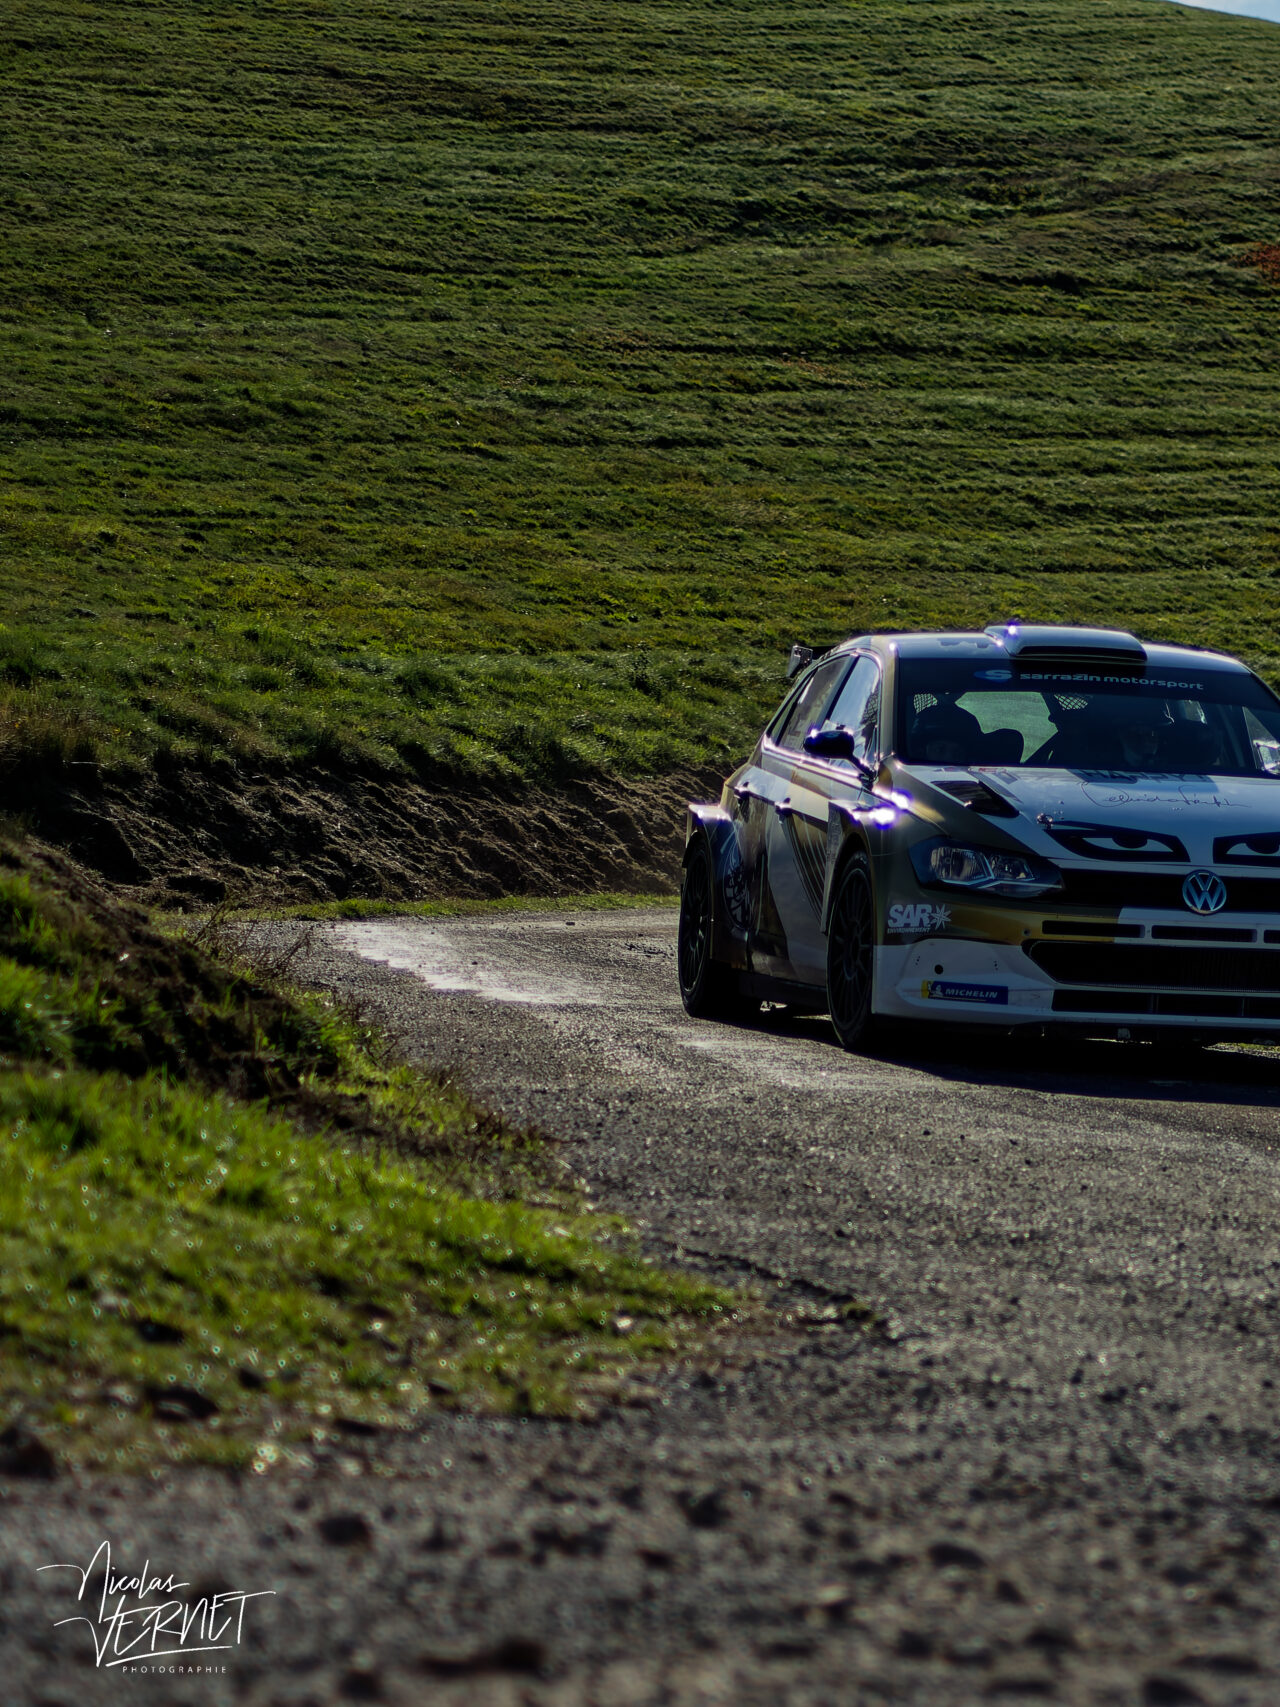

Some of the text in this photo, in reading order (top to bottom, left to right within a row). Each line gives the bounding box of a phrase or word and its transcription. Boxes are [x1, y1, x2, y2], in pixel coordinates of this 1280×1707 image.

[1019, 672, 1101, 683] sarrazin
[1103, 675, 1205, 691] motorsport
[887, 903, 932, 928] SAR
[945, 988, 999, 999] MICHELIN
